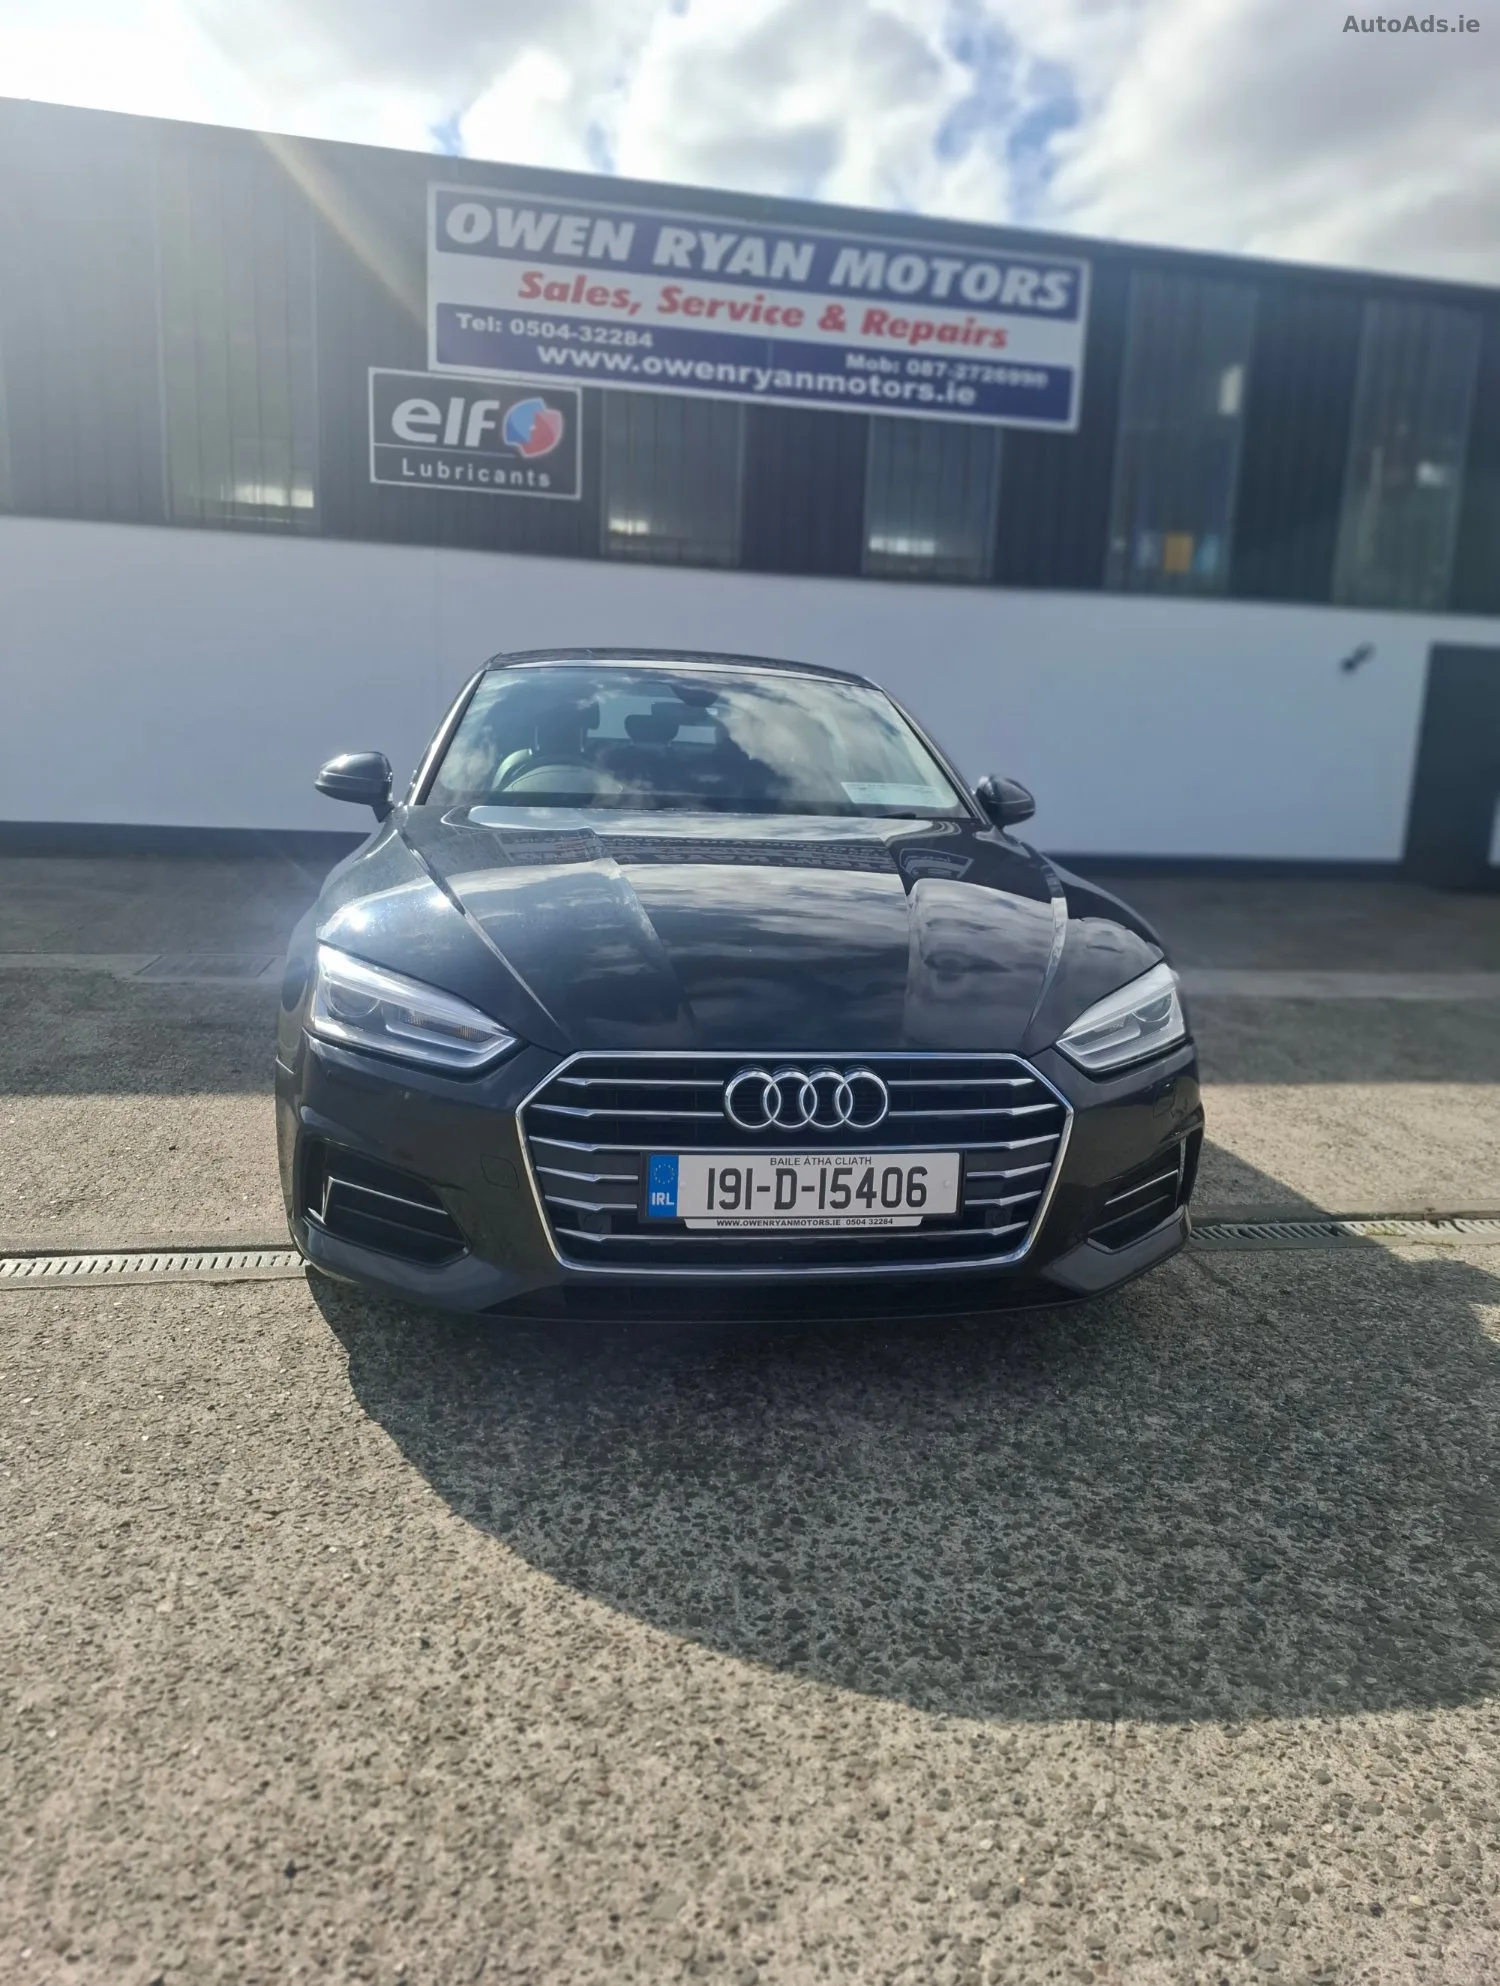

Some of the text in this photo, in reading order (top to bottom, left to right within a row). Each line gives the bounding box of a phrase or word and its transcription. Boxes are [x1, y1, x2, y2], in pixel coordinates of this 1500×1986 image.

[446, 202, 1072, 310] OWEN RYAN MOTORS
[518, 271, 1008, 349] Sales, Service & Repairs
[456, 312, 654, 348] Tel: 0504-32284
[537, 345, 977, 406] www.owenryanmotors.ie
[845, 352, 900, 374] Mob:
[391, 397, 500, 447] elf
[401, 457, 551, 488] Lubricants
[770, 1154, 872, 1166] BAILE ÁTHA CLIATH
[651, 1192, 675, 1206] IRL
[706, 1166, 928, 1211] 191-D-15406
[716, 1217, 894, 1227] WWW.OWENRYANMOTORS.IE 0504 32284
